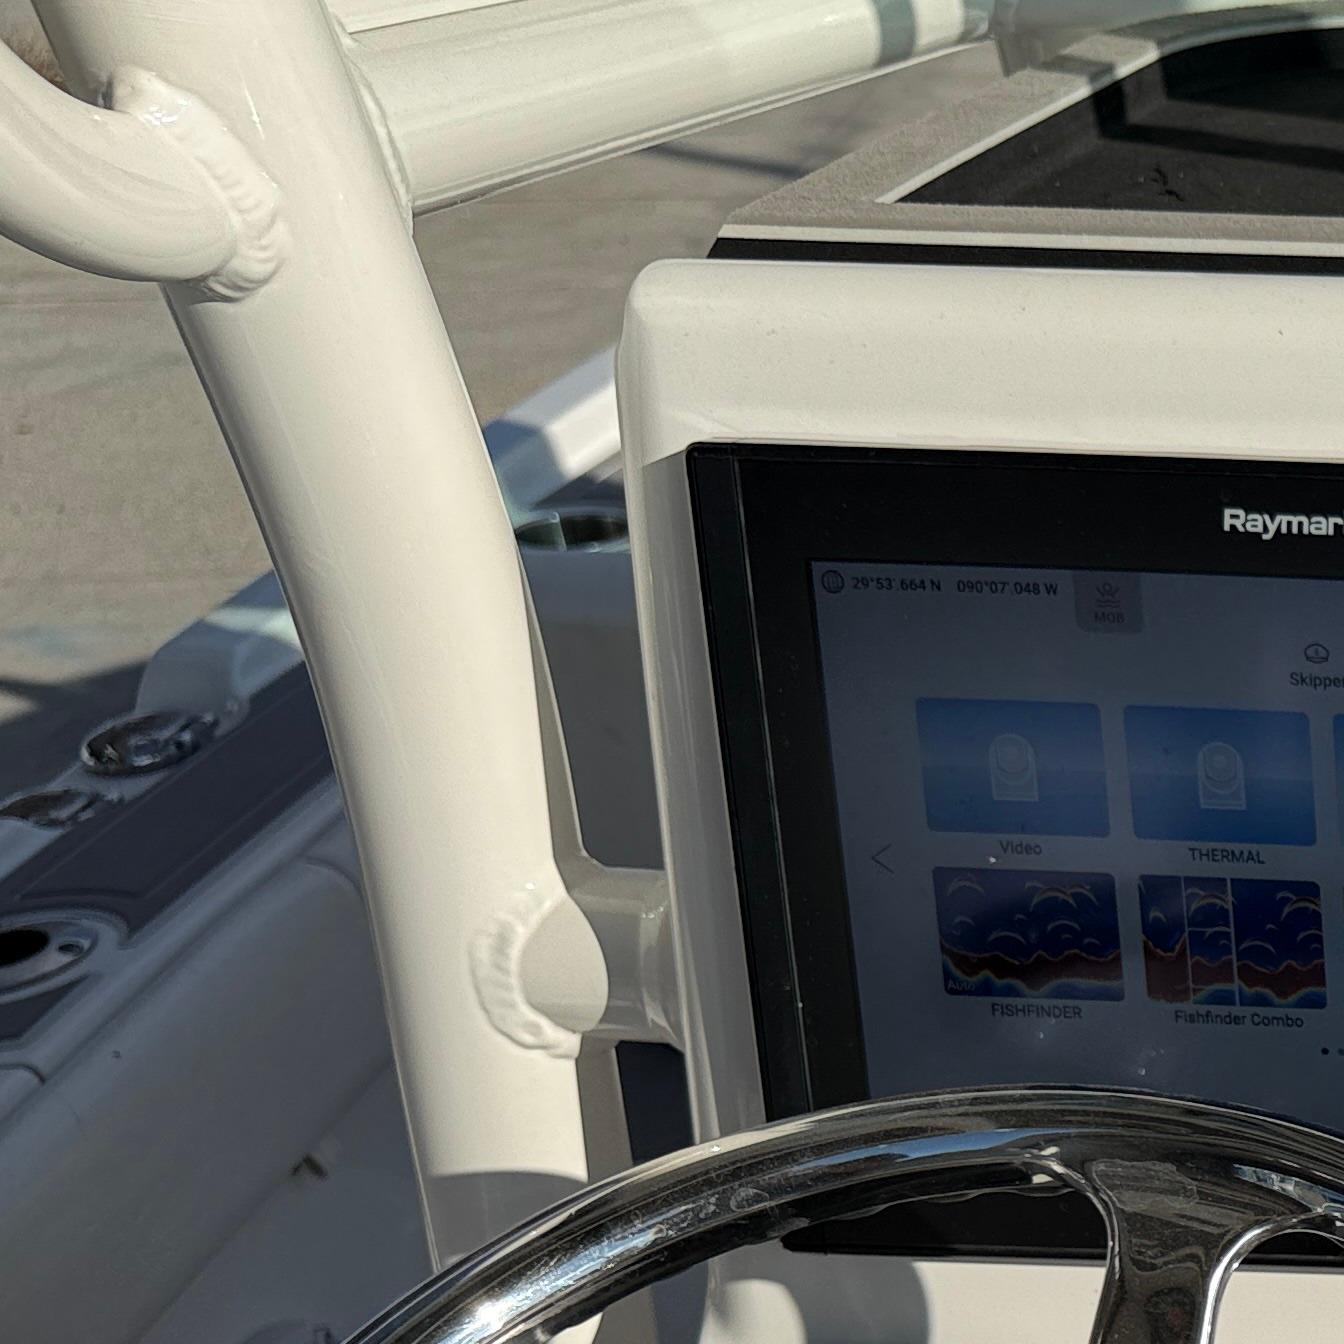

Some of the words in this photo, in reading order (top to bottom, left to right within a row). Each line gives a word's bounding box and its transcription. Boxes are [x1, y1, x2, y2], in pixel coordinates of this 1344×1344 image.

[930, 580, 942, 592] N
[1045, 583, 1059, 596] W
[998, 839, 1043, 856] Video
[1188, 847, 1266, 865] THERMAL
[991, 1002, 1083, 1020] FISHFINDER
[1174, 1008, 1247, 1027] Fishfinder
[1251, 1012, 1305, 1029] Combo
